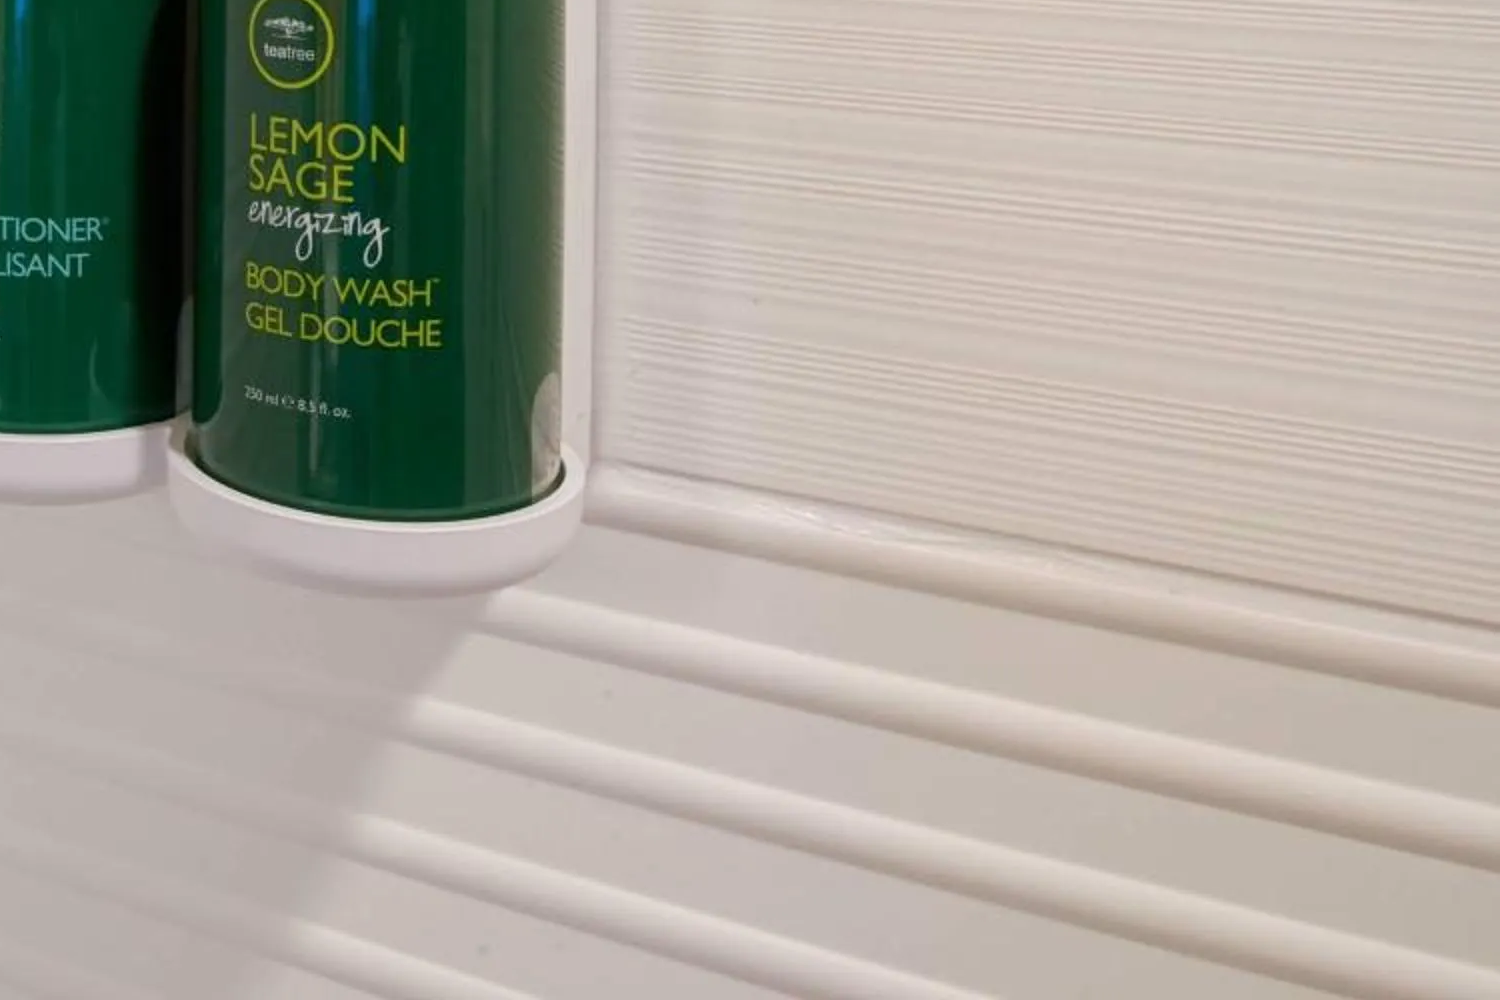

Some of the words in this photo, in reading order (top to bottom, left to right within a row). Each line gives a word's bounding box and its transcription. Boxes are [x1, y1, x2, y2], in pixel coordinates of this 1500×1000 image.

[263, 42, 315, 62] teatree
[250, 112, 406, 164] LEMON
[249, 153, 355, 203] SAGE
[248, 199, 390, 269] energizing
[245, 262, 324, 300] BODY
[245, 302, 293, 338] GEL
[301, 312, 443, 349] DOUCHE
